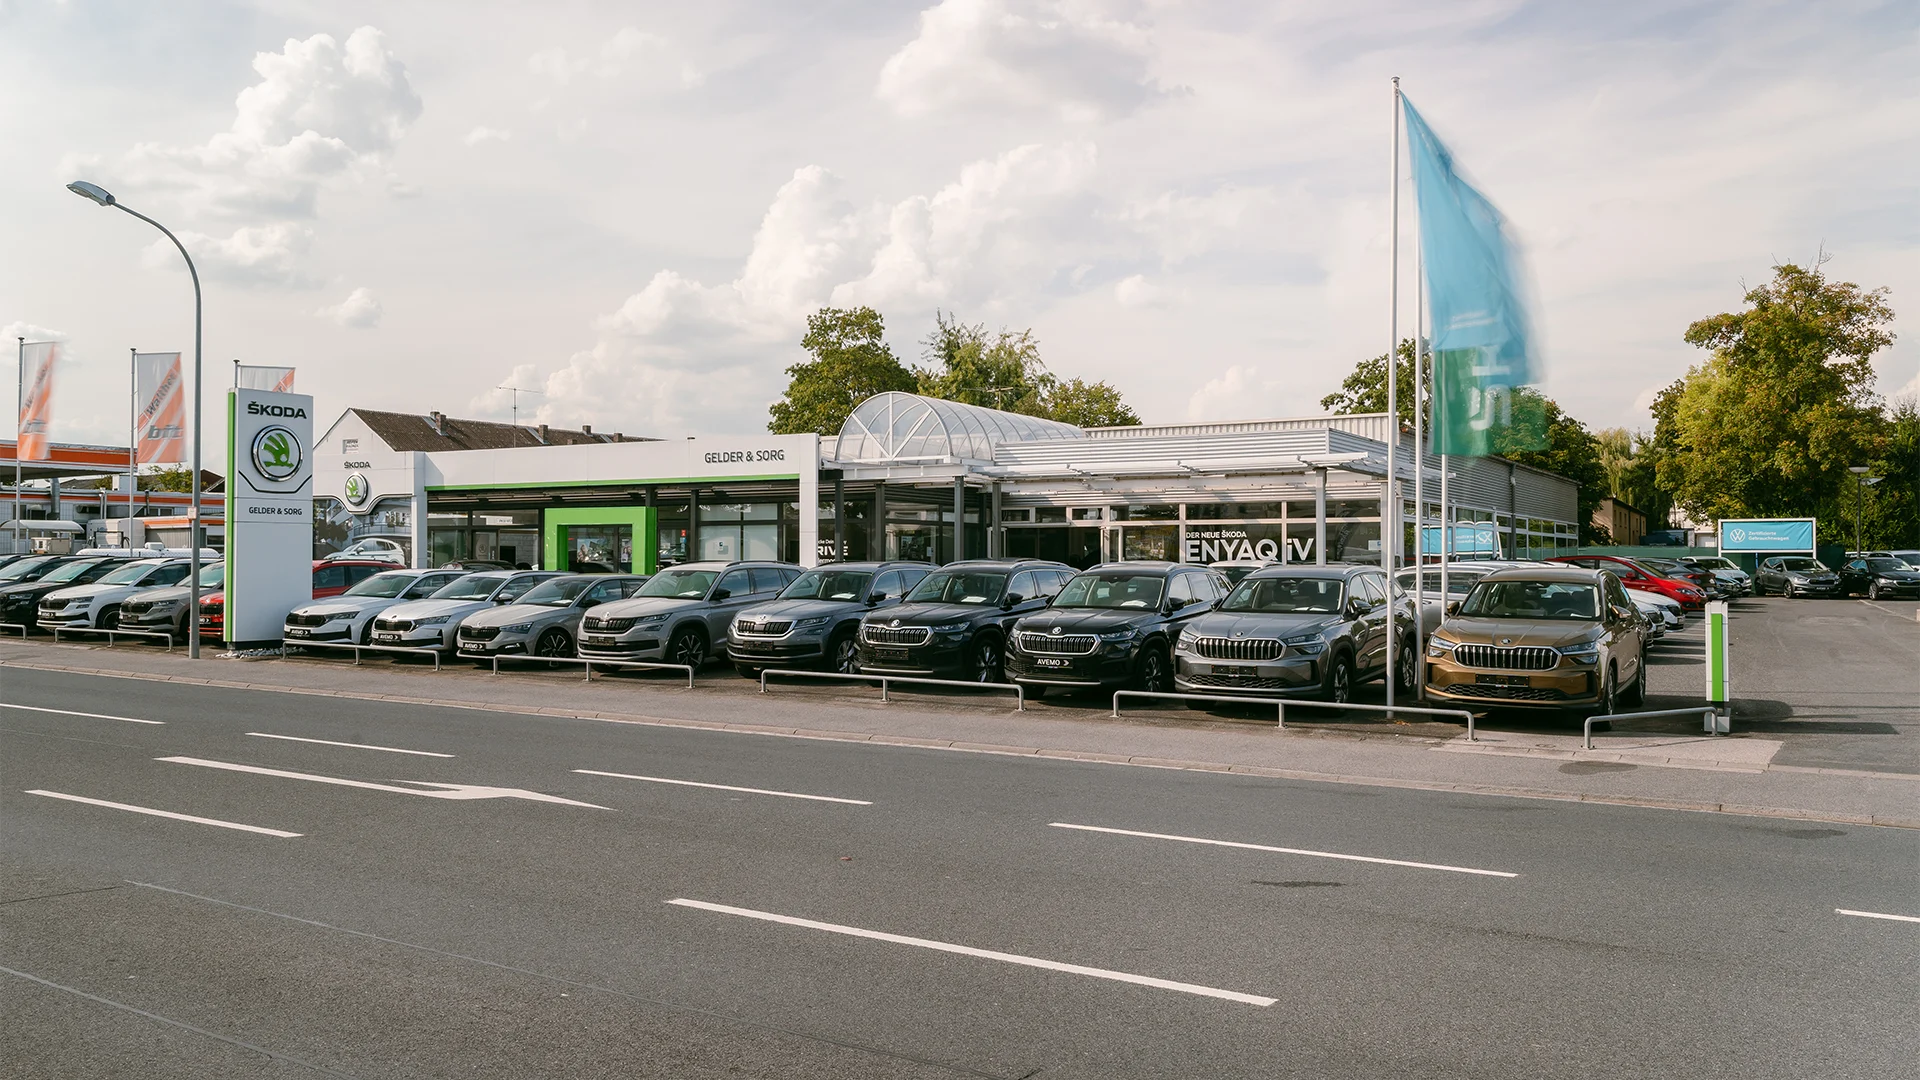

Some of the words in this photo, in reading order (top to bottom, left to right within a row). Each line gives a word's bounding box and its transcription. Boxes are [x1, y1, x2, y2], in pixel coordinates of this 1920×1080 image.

[247, 401, 307, 419] ŠKODA
[704, 451, 744, 463] GELDER
[746, 451, 754, 462] &
[756, 450, 785, 461] SORG
[344, 461, 371, 469] ŠKODA
[248, 506, 276, 515] GELDER
[276, 507, 283, 515] &
[283, 507, 303, 516] SORG
[1221, 529, 1247, 538] ŠKODA
[1186, 538, 1279, 562] ENYAQ
[1287, 538, 1314, 561] iV
